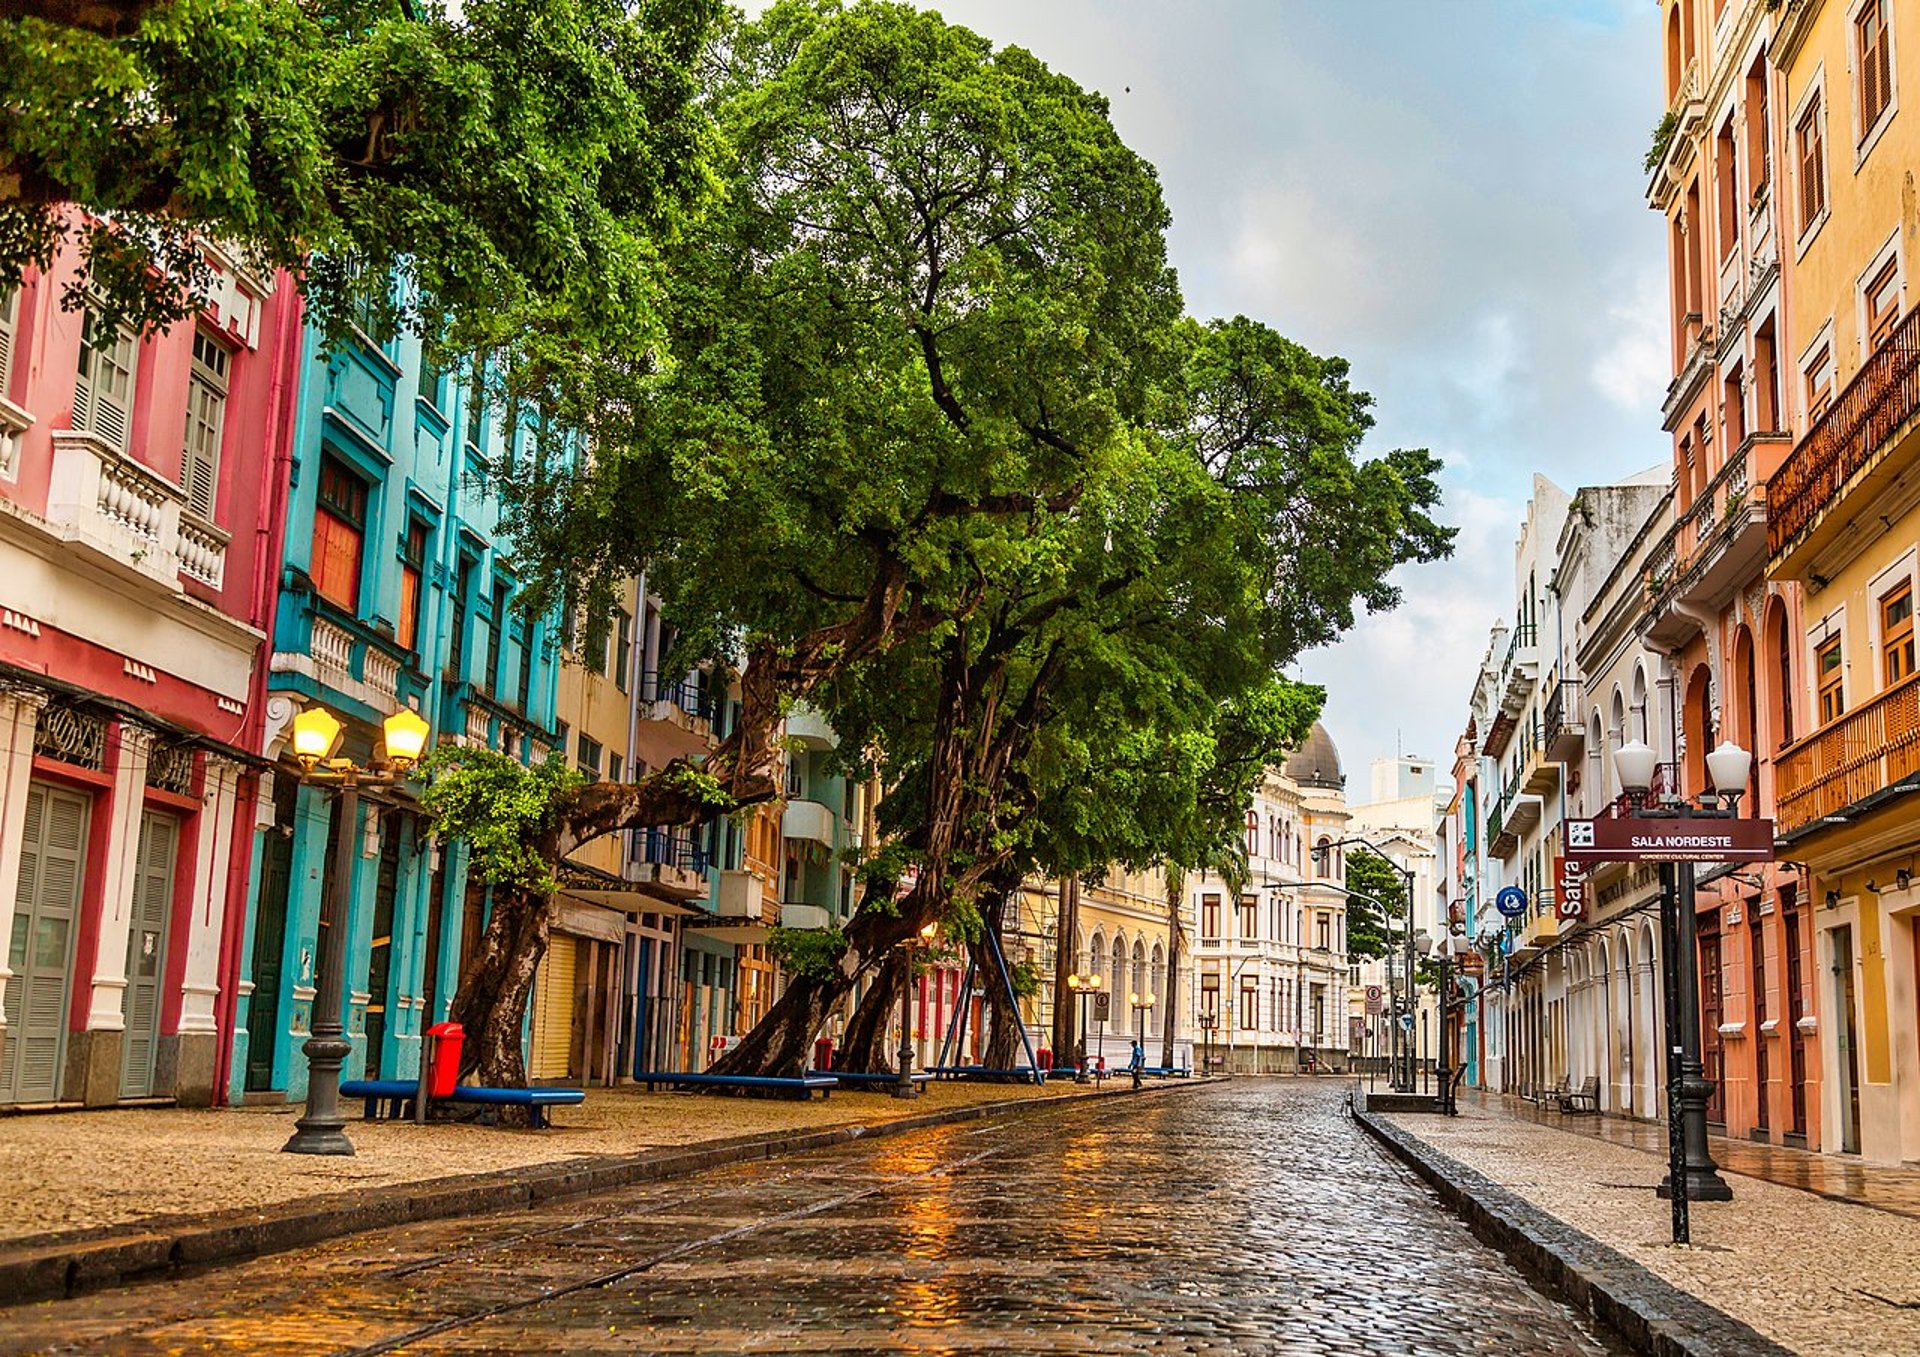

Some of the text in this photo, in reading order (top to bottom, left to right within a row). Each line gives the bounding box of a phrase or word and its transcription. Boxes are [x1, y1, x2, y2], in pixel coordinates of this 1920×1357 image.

[1631, 836, 1732, 847] SALA NORDESTE
[1560, 861, 1581, 915] Safra
